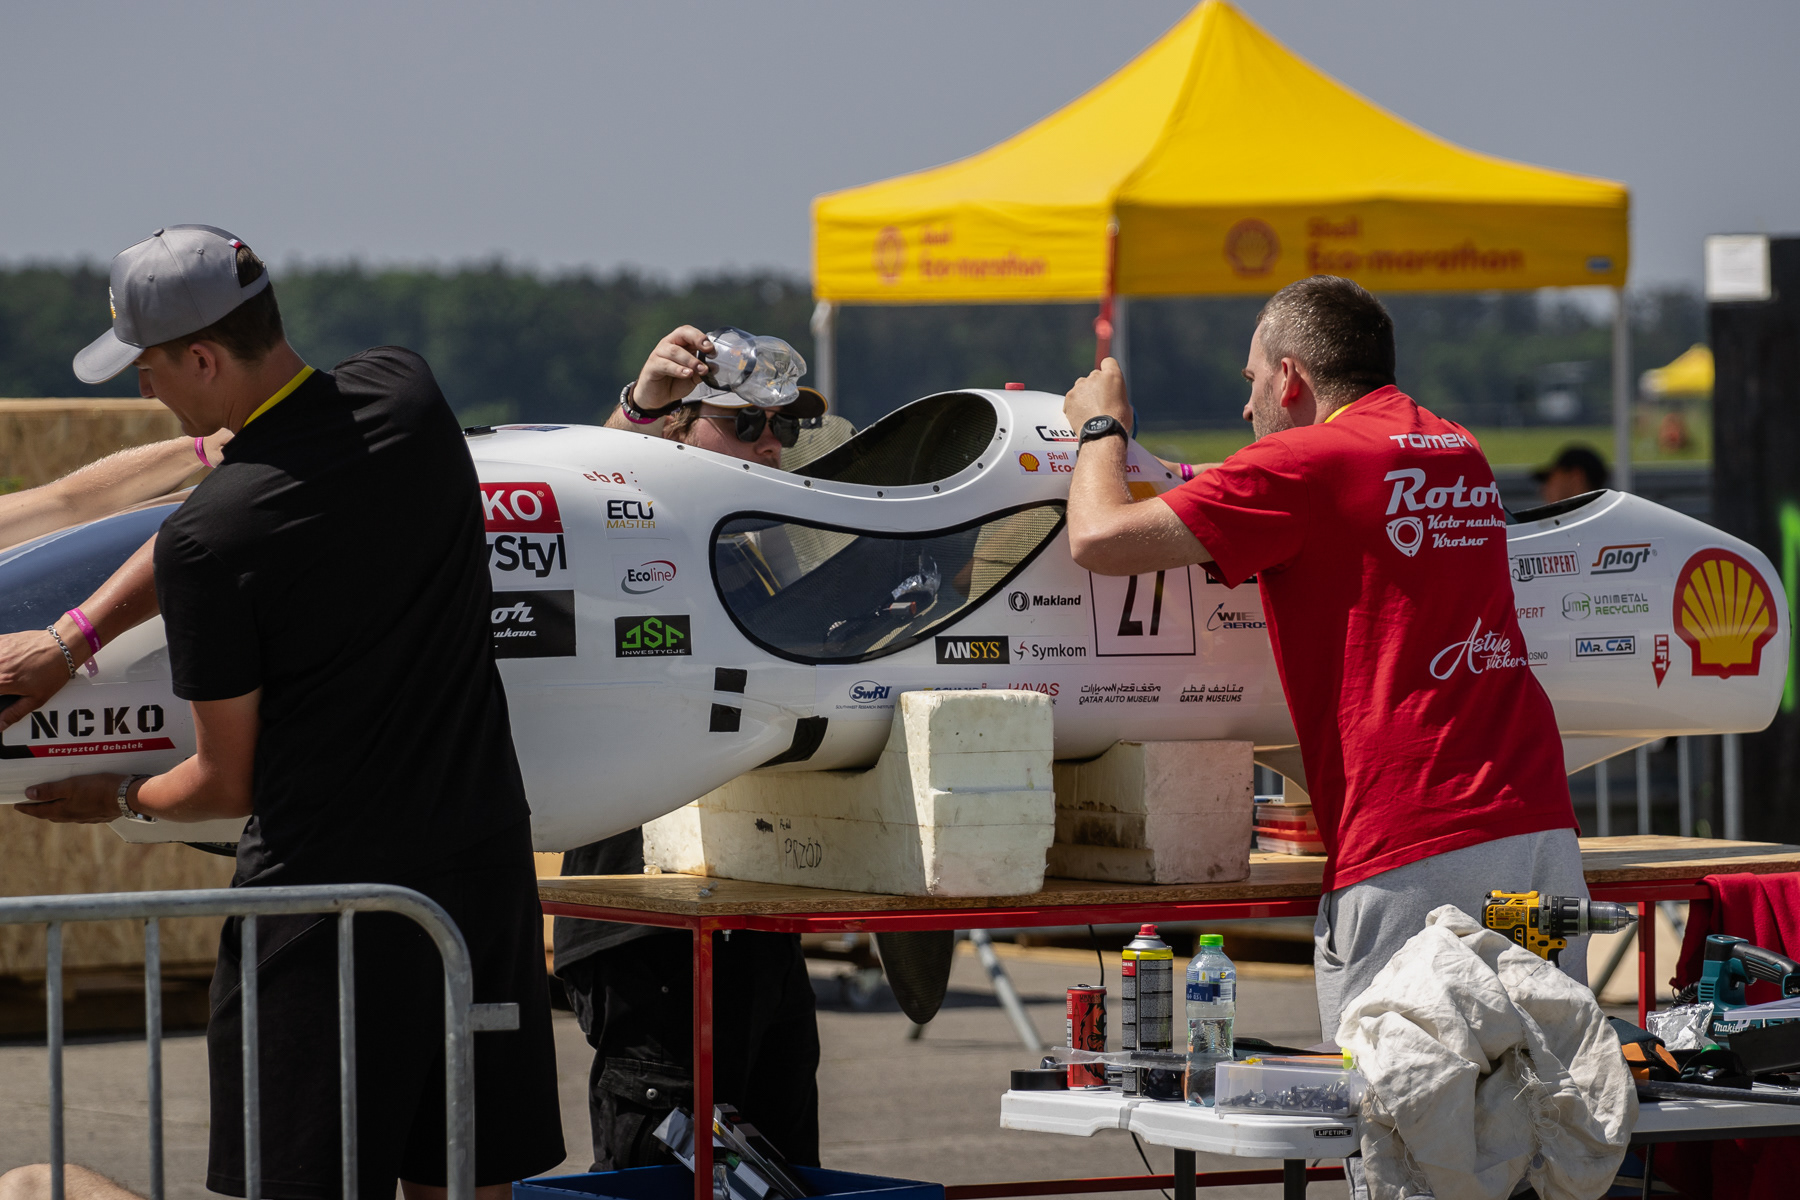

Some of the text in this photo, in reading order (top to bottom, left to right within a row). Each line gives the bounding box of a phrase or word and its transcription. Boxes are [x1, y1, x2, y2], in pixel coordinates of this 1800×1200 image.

[1389, 433, 1473, 448] TOMEK
[1047, 451, 1069, 460] Shell
[607, 500, 654, 519] ECU
[606, 520, 656, 528] MASTER
[1432, 533, 1488, 548] Krosno
[1519, 555, 1576, 575] AUTOEXPERT
[628, 569, 672, 582] Ecoline
[1033, 595, 1081, 606] Makland
[1594, 593, 1648, 604] UNIMETAL
[1595, 604, 1649, 615] RECYCLING
[494, 628, 537, 637] ukowe
[944, 642, 1001, 658] ANSYS
[1032, 644, 1086, 660] Symkom
[1655, 636, 1667, 671] LIFT
[852, 686, 891, 699] SwRI
[1205, 694, 1242, 702] MUSEUMS
[1079, 695, 1159, 705] QATAR AUTO MUSEUM
[48, 745, 100, 754] Krzysztof
[1714, 1022, 1743, 1032] Maki
